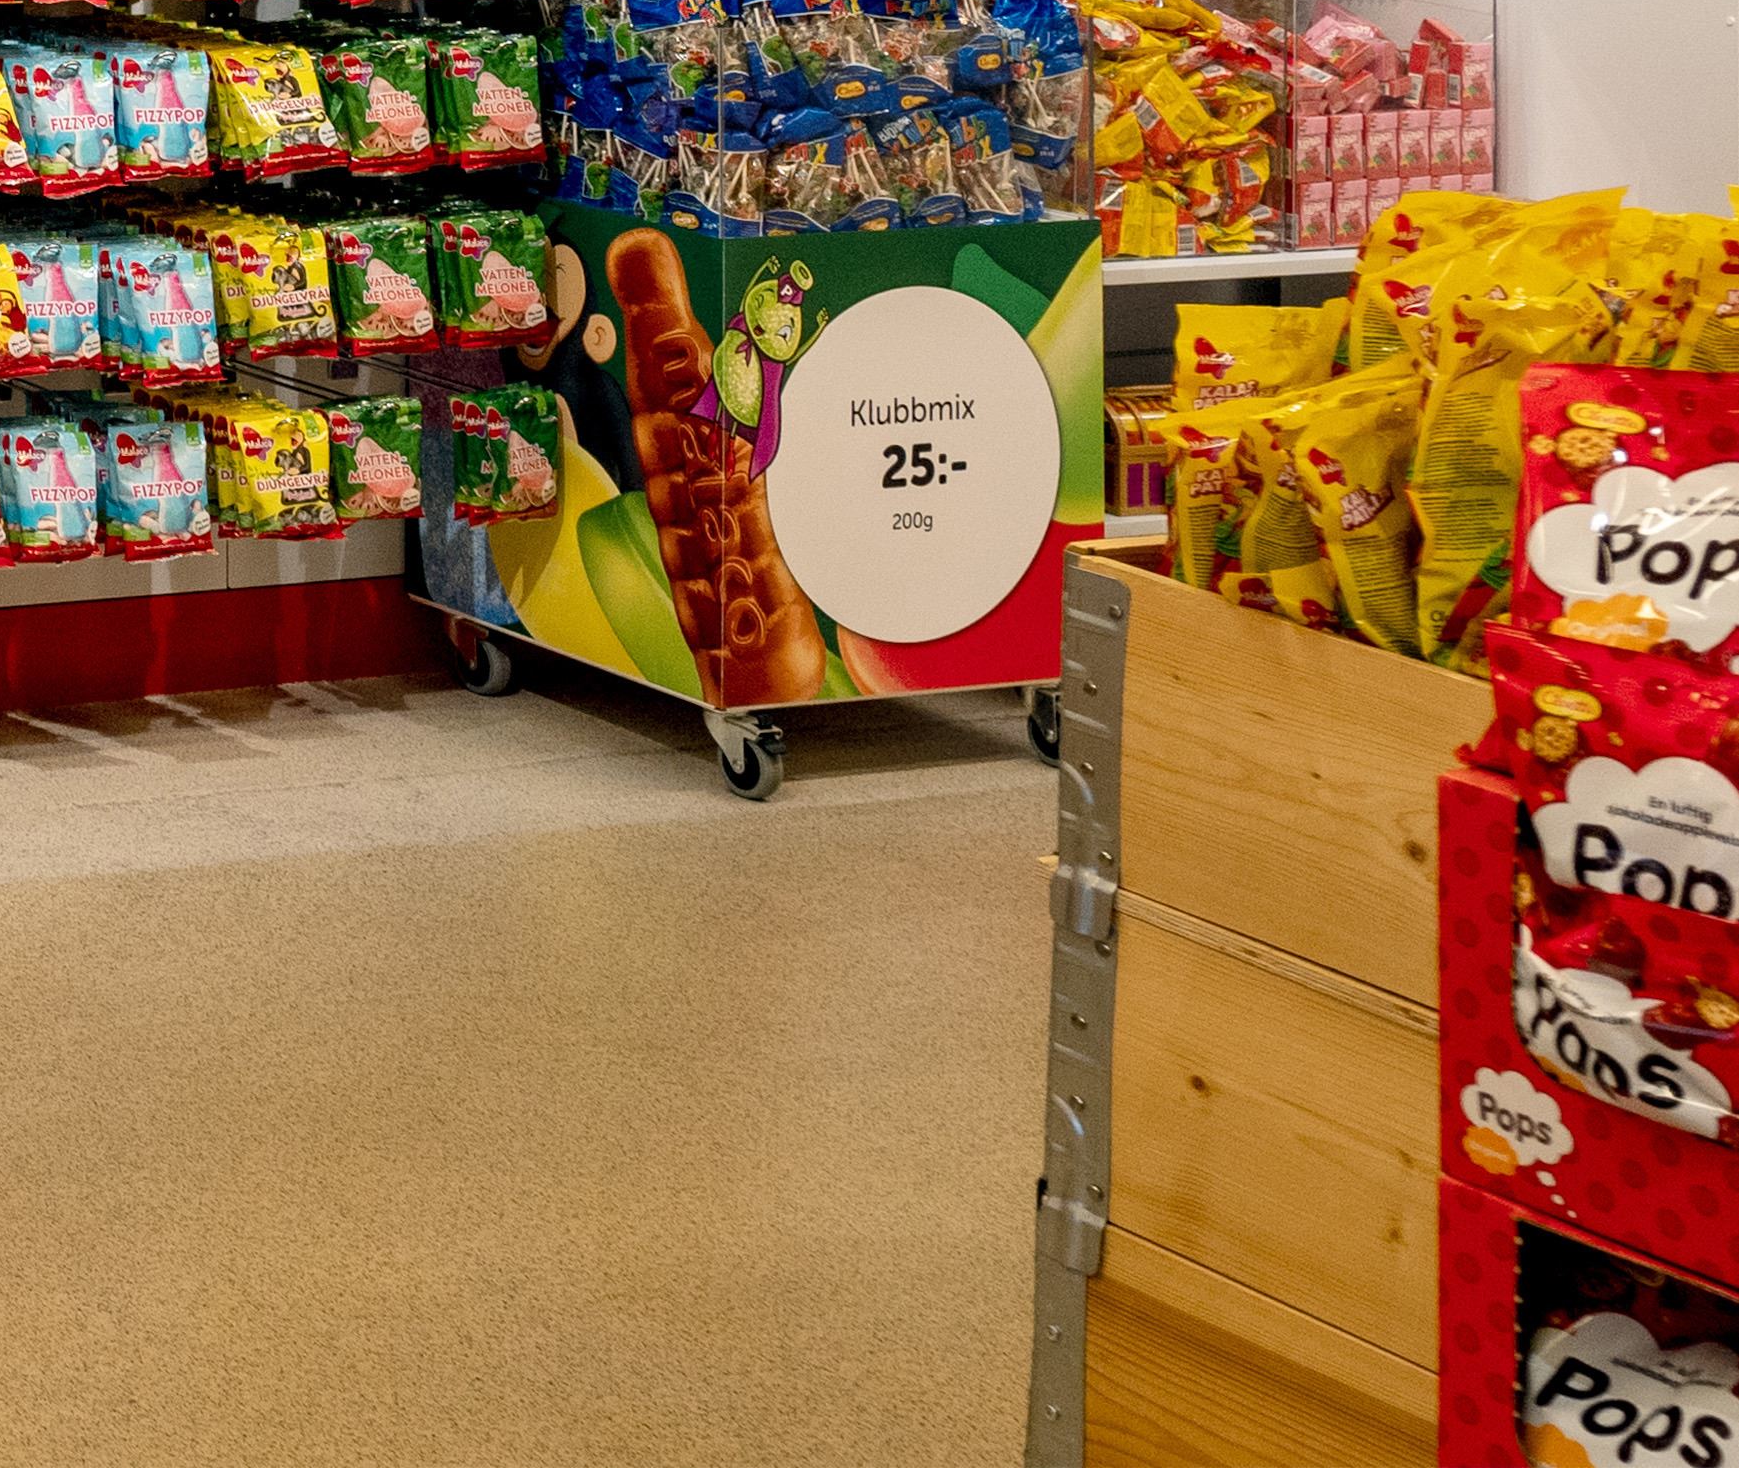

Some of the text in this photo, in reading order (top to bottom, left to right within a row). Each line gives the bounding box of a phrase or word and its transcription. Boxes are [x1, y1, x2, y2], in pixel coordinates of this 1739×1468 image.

[134, 107, 206, 125] FIZZYPOP
[361, 287, 424, 305] MELONER
[781, 285, 793, 298] P
[851, 394, 975, 427] Klubbmix
[347, 463, 411, 482] MELONER
[882, 443, 967, 488] 25:-
[131, 481, 203, 500] FIZZYPOP
[892, 513, 934, 532] 200g
[1477, 1090, 1552, 1145] Pops
[1535, 1357, 1733, 1468] Pops
